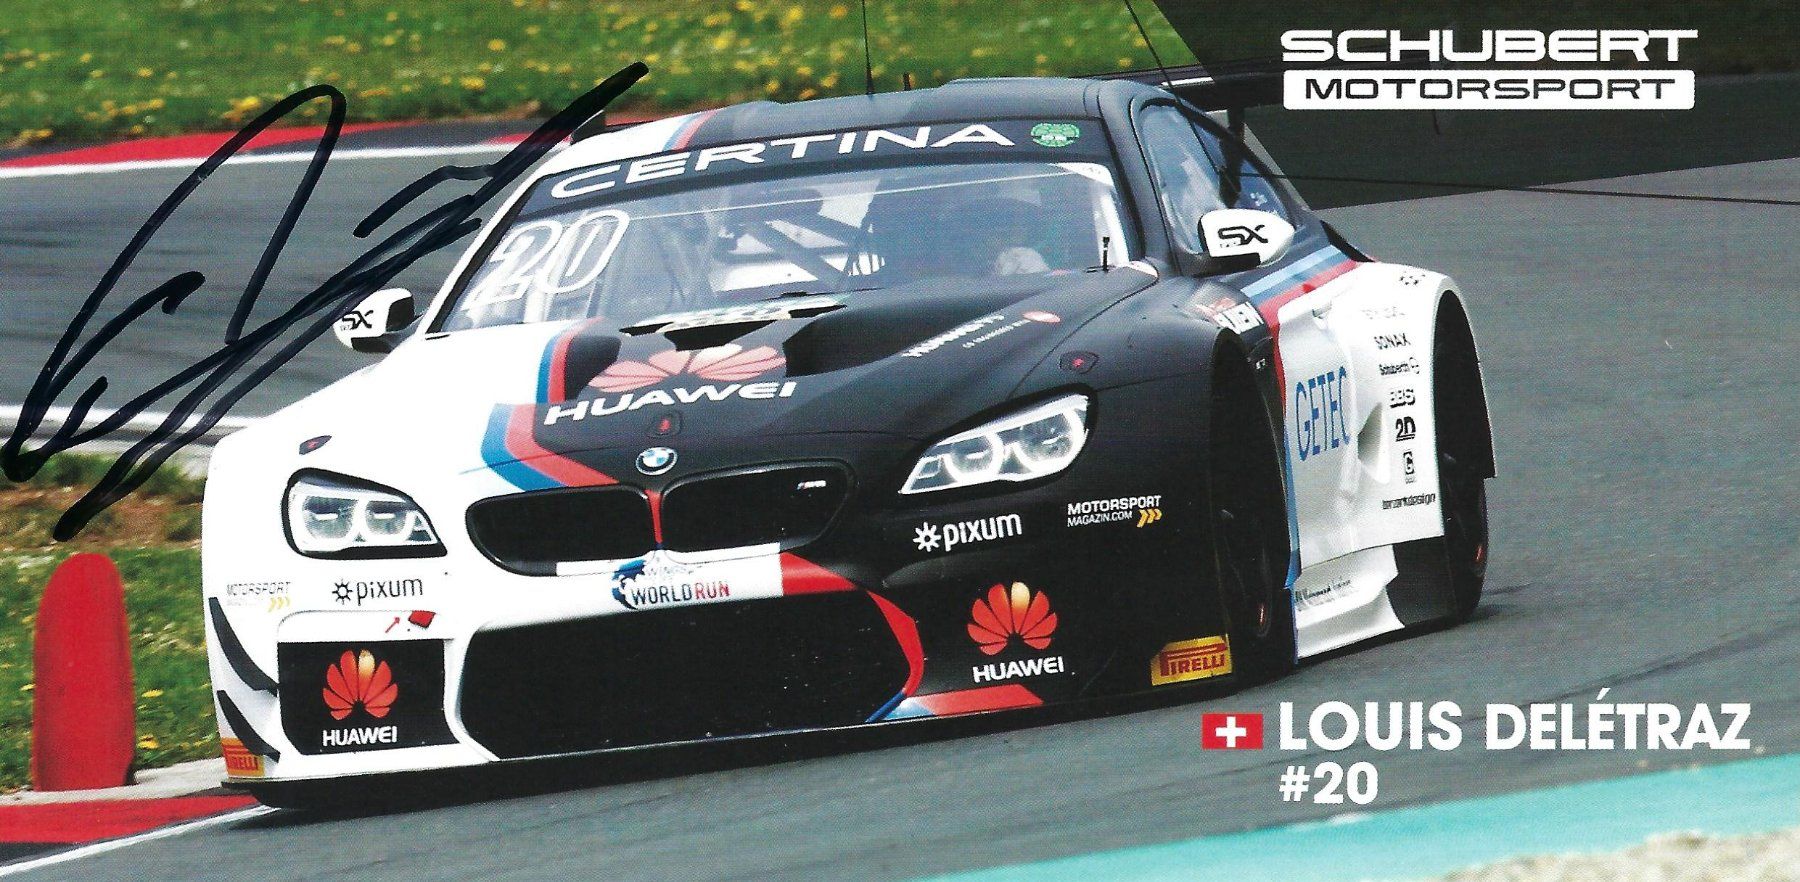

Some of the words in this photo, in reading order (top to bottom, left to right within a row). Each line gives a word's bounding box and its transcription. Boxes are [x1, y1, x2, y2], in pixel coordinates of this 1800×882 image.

[551, 124, 1016, 198] CERTINA
[1217, 224, 1269, 246] SX
[460, 209, 630, 311] 20
[1374, 333, 1411, 349] SONAX
[544, 381, 797, 425] HUAWEI
[1296, 366, 1349, 461] GETEC
[1067, 495, 1161, 515] MOTORSPORT
[1067, 510, 1133, 527] MAGAZIN.COM
[943, 514, 1022, 551] pixum
[227, 582, 291, 596] MOTORSPORT
[357, 579, 423, 606] pixum
[972, 656, 1064, 683] HUAWEI
[1160, 643, 1227, 677] PIRELLI
[322, 725, 398, 747] HUAWEI
